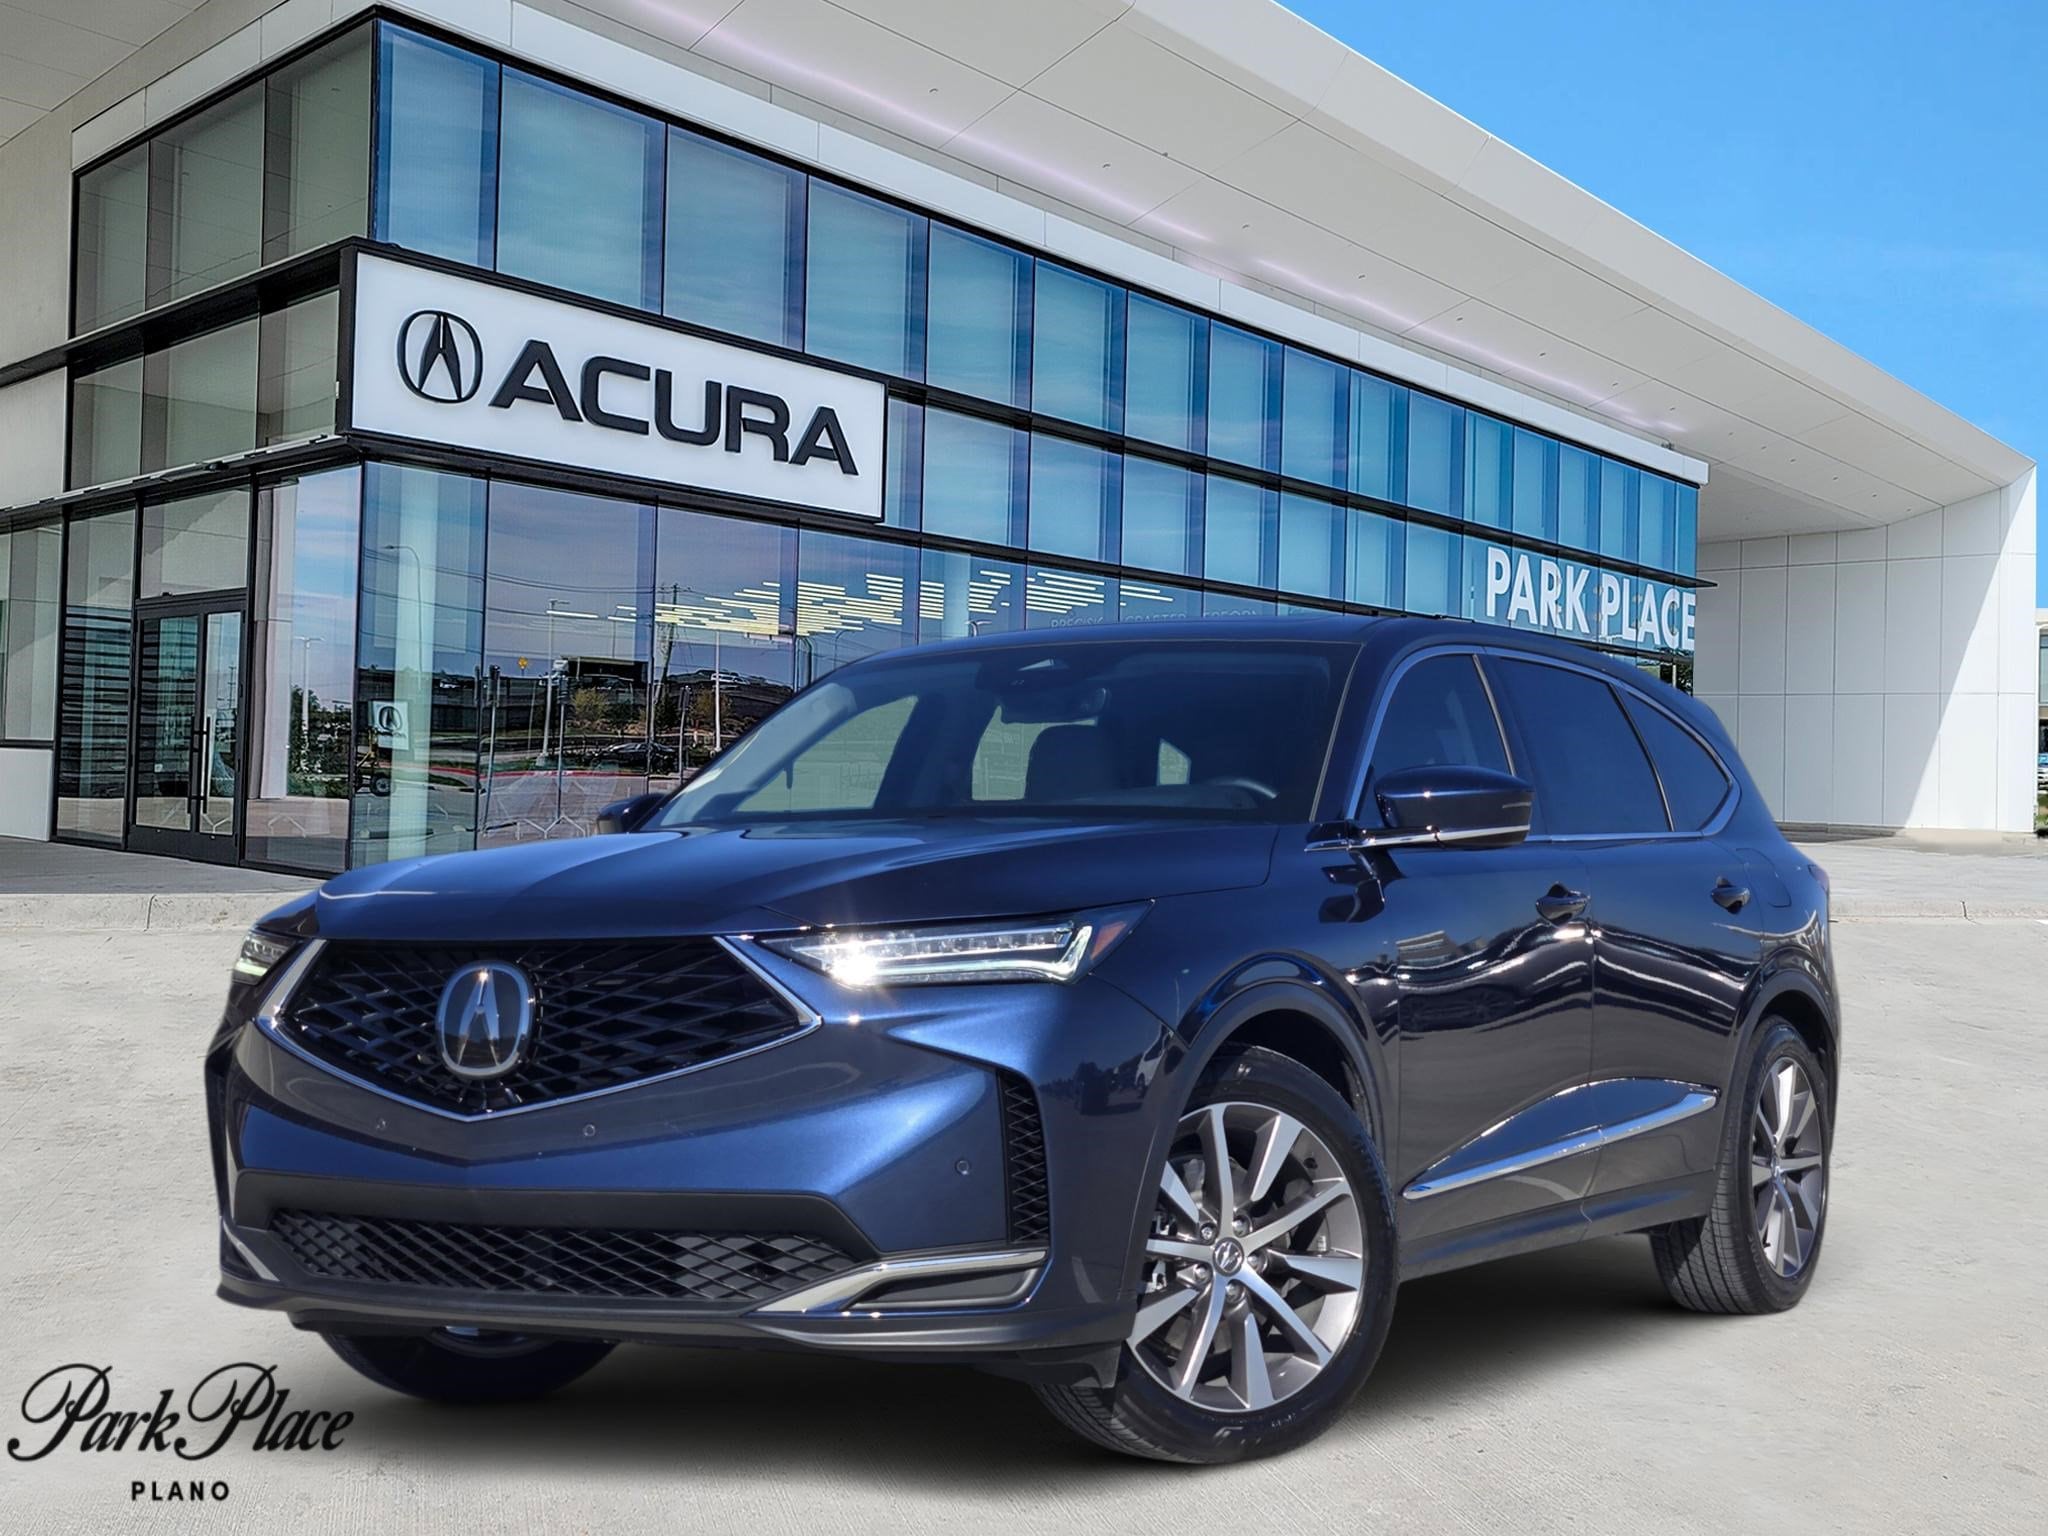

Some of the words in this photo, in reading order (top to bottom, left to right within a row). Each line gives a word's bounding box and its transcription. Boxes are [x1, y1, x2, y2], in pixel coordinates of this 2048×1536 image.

[488, 339, 859, 476] ACURA
[1486, 546, 1590, 634] PARK
[1601, 573, 1697, 651] PLACE
